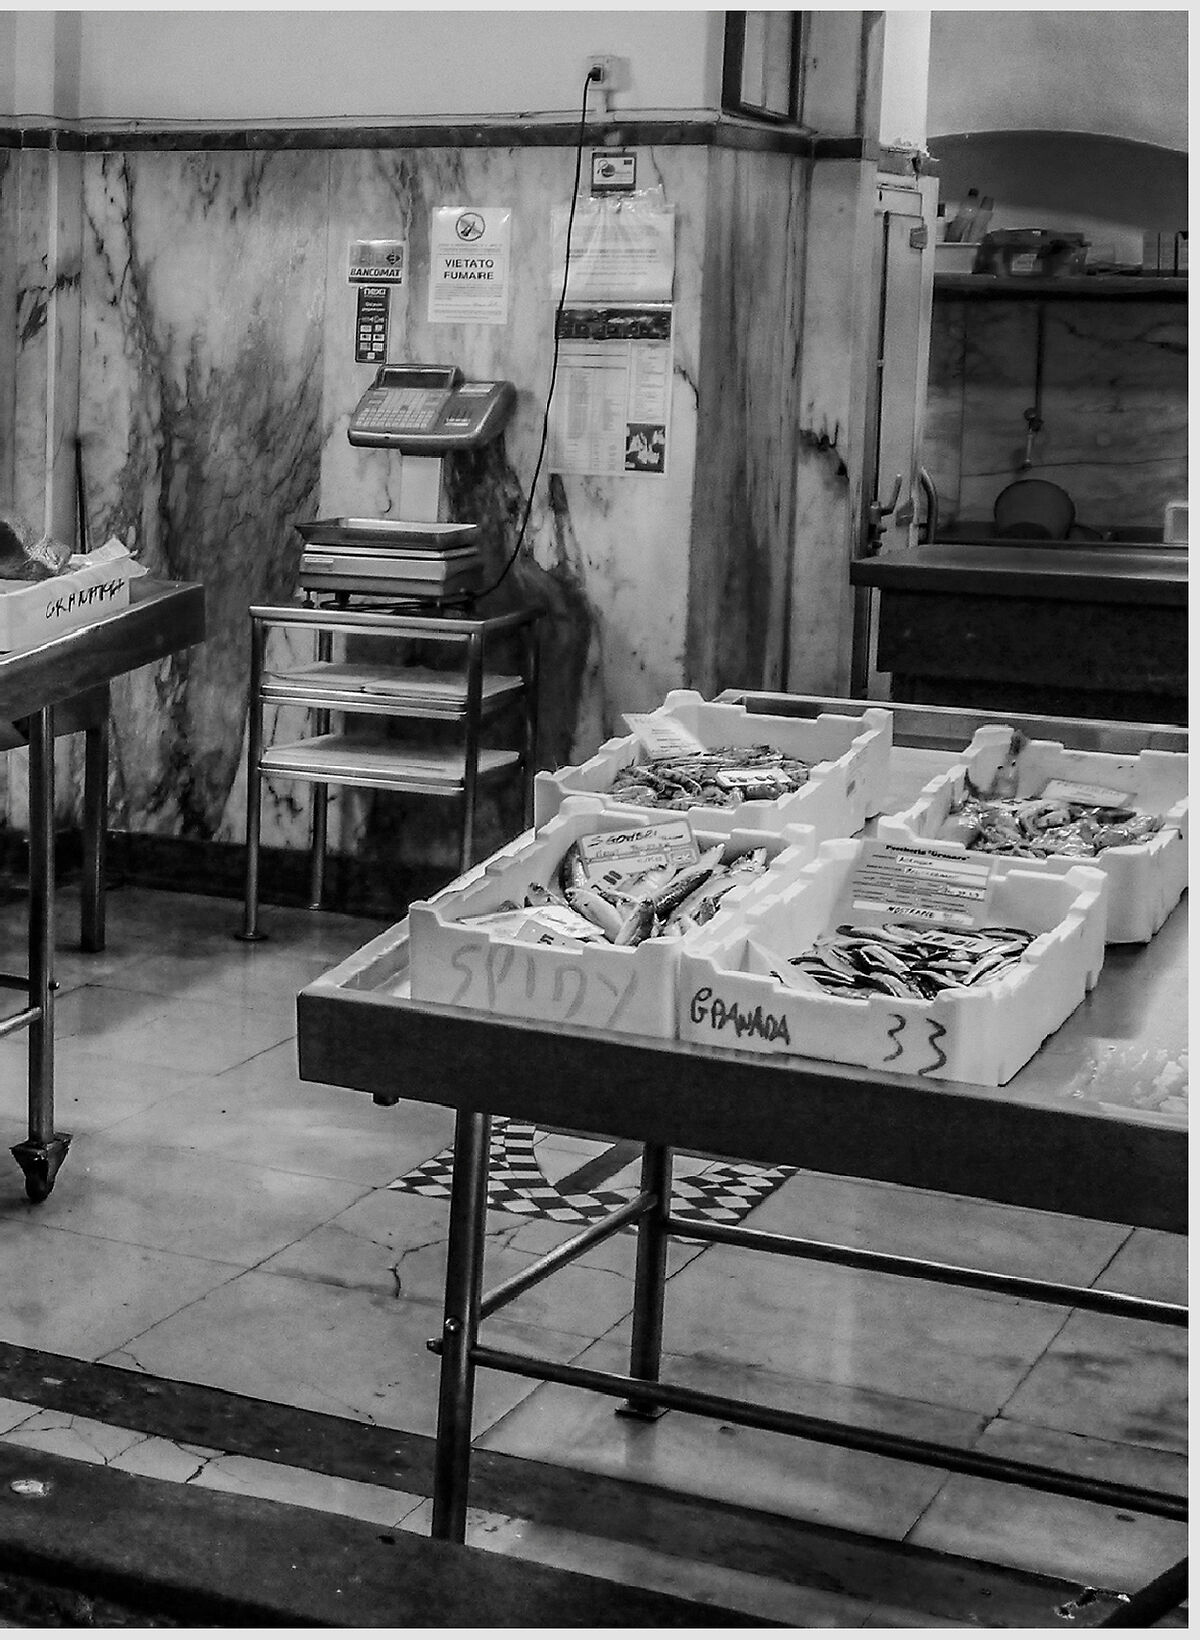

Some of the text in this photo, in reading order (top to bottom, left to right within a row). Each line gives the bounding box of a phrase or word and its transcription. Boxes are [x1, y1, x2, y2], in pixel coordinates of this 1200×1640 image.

[445, 258, 495, 269] VIETATO
[350, 267, 401, 277] BANCOMAT
[443, 271, 494, 280] FUMARE
